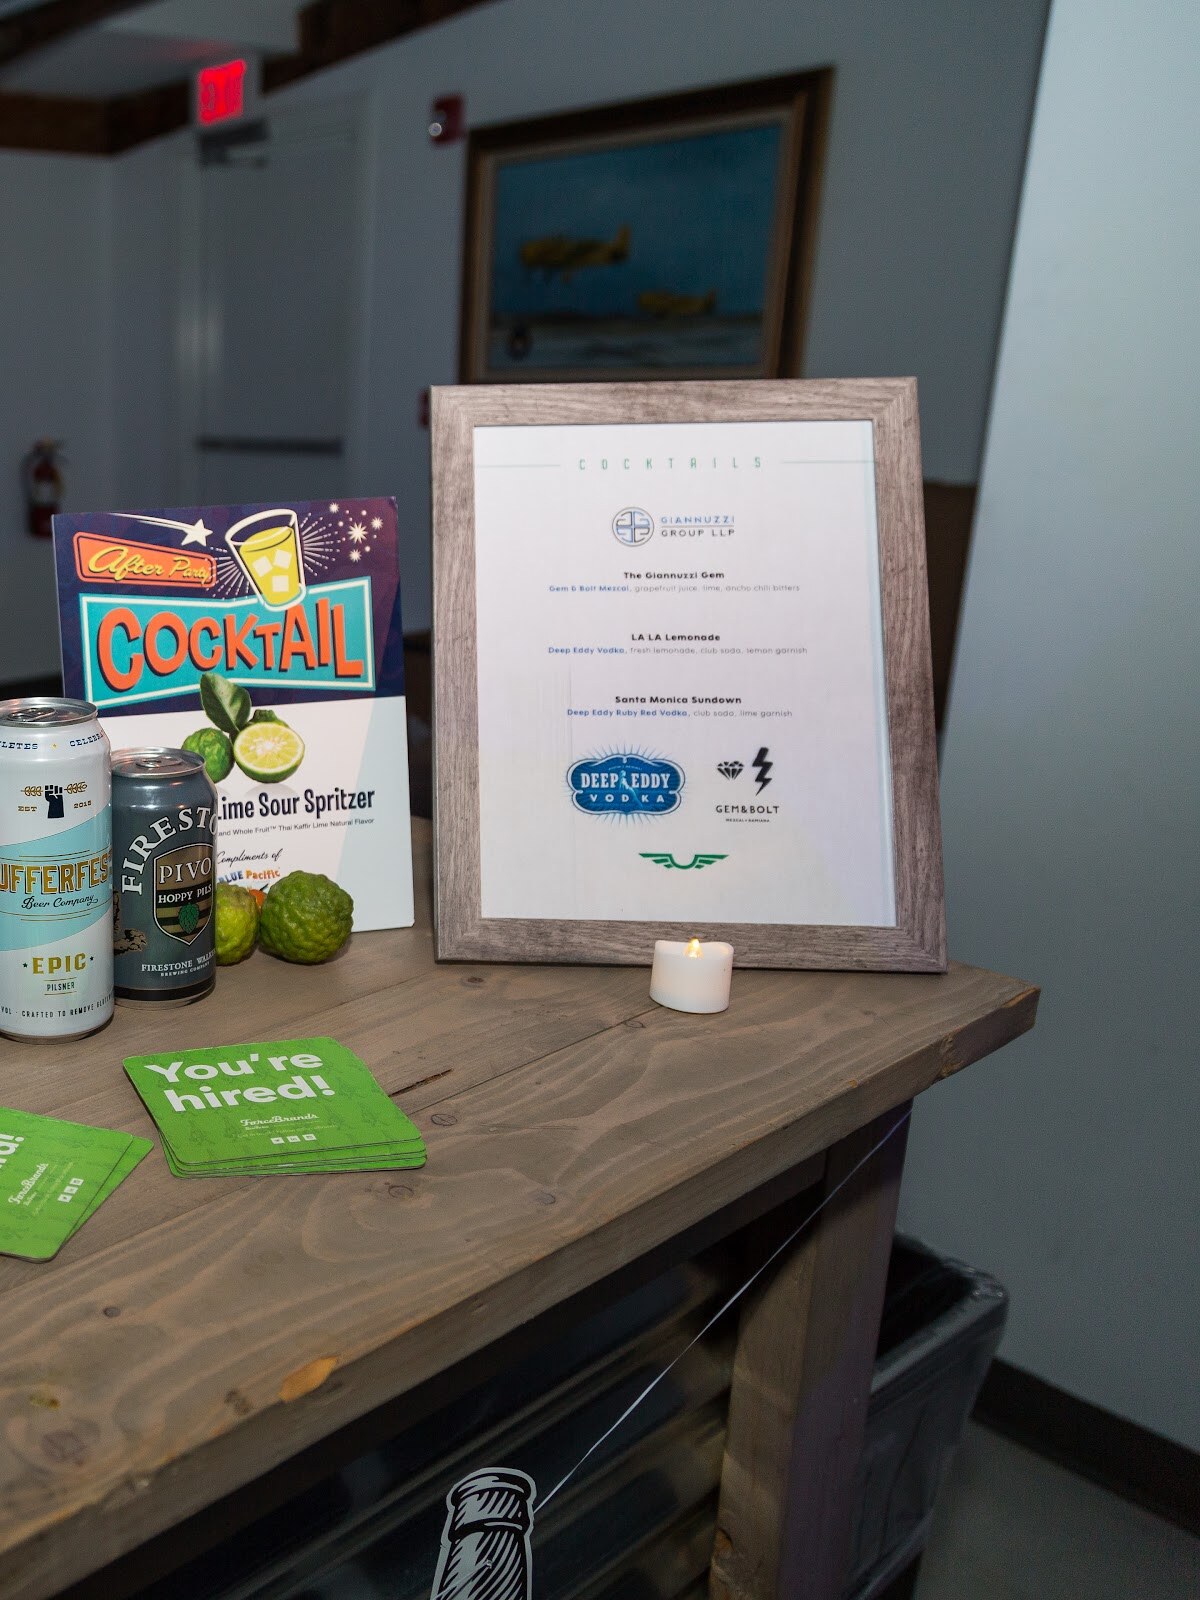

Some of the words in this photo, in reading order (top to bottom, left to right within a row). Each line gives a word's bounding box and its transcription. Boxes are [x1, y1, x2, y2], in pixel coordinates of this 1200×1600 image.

[579, 456, 762, 471] COCKTAILS
[660, 515, 736, 524] GIANNUZZI
[660, 529, 705, 538] GROUP
[711, 529, 736, 537] LLP
[88, 546, 164, 581] After
[169, 556, 209, 585] Party
[623, 571, 642, 579] The
[645, 571, 698, 579] Giannuzzi
[701, 571, 725, 579] Gem
[549, 585, 569, 593] Gem
[665, 634, 721, 642] Lemonade
[98, 598, 364, 691] COCKTAIL
[548, 646, 571, 655] Deep
[573, 646, 594, 655] Eddy
[630, 646, 651, 654] fresh
[700, 646, 718, 654] club
[615, 695, 646, 704] Santa
[649, 695, 689, 704] Monica
[691, 695, 742, 704] Sundown
[567, 708, 590, 717] Deep
[592, 708, 614, 717] Eddy
[616, 708, 638, 717] Ruby
[640, 708, 657, 716] Red
[693, 709, 711, 717] club
[760, 709, 793, 718] garnish
[580, 773, 619, 788] DEEP
[631, 773, 671, 788] EDDY
[218, 796, 255, 820] ime
[259, 792, 300, 816] Sour
[304, 787, 375, 819] Spritzer
[590, 794, 665, 803] VODKA
[715, 805, 780, 814] GEM&BOLT
[278, 824, 292, 832] Thai
[217, 848, 269, 868] Compliments
[272, 848, 283, 862] of
[159, 857, 212, 884] PIVO
[246, 869, 280, 880] Pacific
[158, 890, 194, 904] HOPPY
[197, 883, 212, 898] PILS
[21, 896, 50, 909] Beer
[53, 895, 98, 908] Company
[32, 952, 87, 975] EPIC
[141, 958, 193, 972] FIRESTONE
[47, 981, 75, 992] PILSNER
[70, 1004, 94, 1016] REMOVE
[143, 1053, 324, 1083] You're
[163, 1075, 336, 1112] hired!
[240, 1113, 319, 1126] ForceBrands
